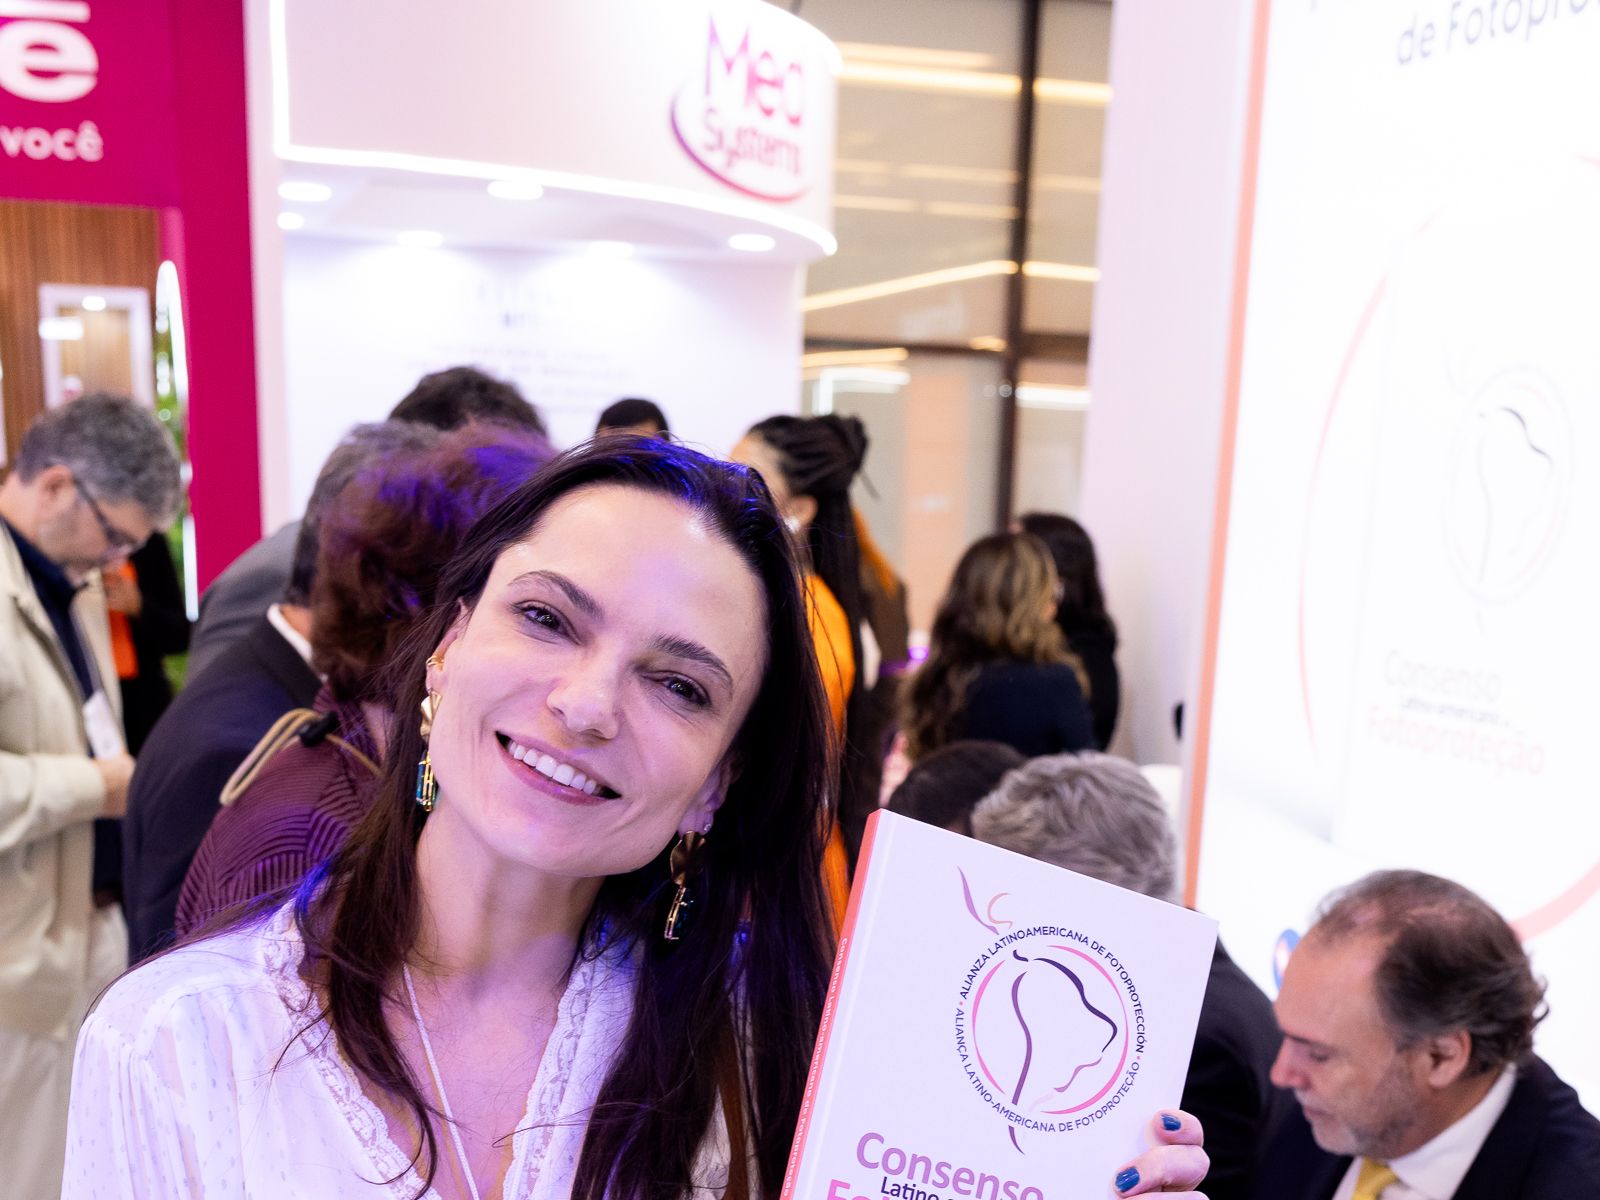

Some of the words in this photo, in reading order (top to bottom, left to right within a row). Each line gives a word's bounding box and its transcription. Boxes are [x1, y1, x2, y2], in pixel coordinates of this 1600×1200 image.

[0, 120, 104, 162] você
[959, 954, 990, 1000] ALIANZA
[988, 926, 1089, 956] LATINOAMERICANA
[1090, 941, 1106, 956] DE
[1105, 952, 1147, 1053] FOTOPROTECCIÓN
[955, 1008, 968, 1062] ALIANÇA
[963, 1063, 1056, 1133] LATINO-AMERICANA
[1058, 1122, 1074, 1132] DE
[1075, 1061, 1140, 1130] FOTOPROTEÇÃO
